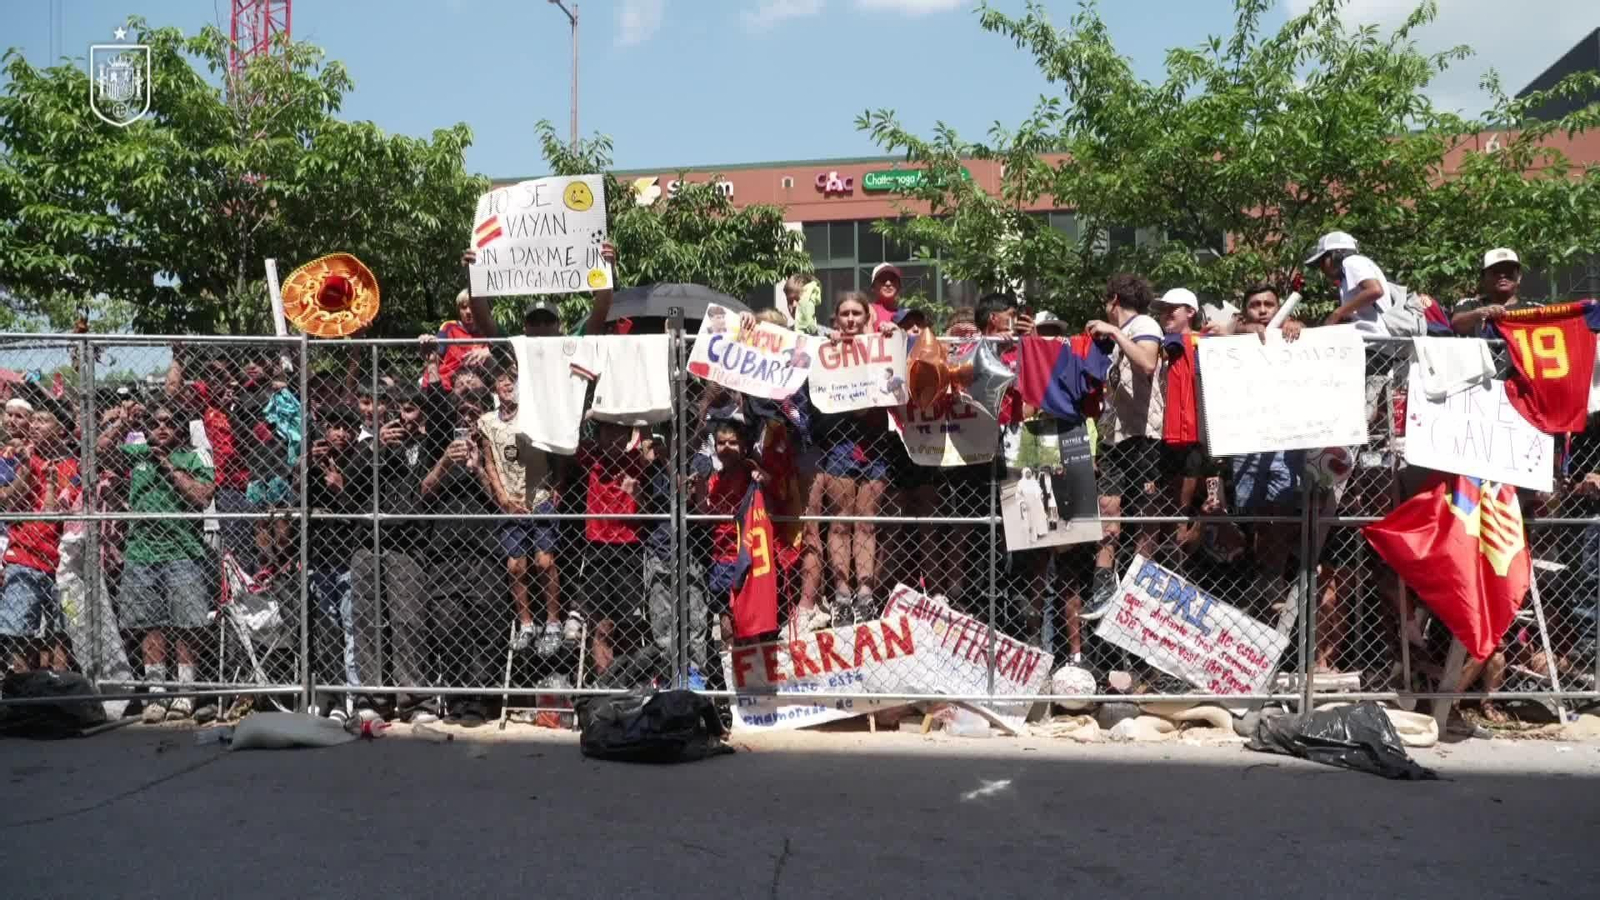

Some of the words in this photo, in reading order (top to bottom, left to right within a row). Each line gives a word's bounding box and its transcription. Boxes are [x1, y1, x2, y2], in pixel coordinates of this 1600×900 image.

[510, 246, 577, 268] DARME
[818, 334, 893, 370] GAVI
[1512, 326, 1570, 379] 19
[732, 616, 915, 688] FERRAN
